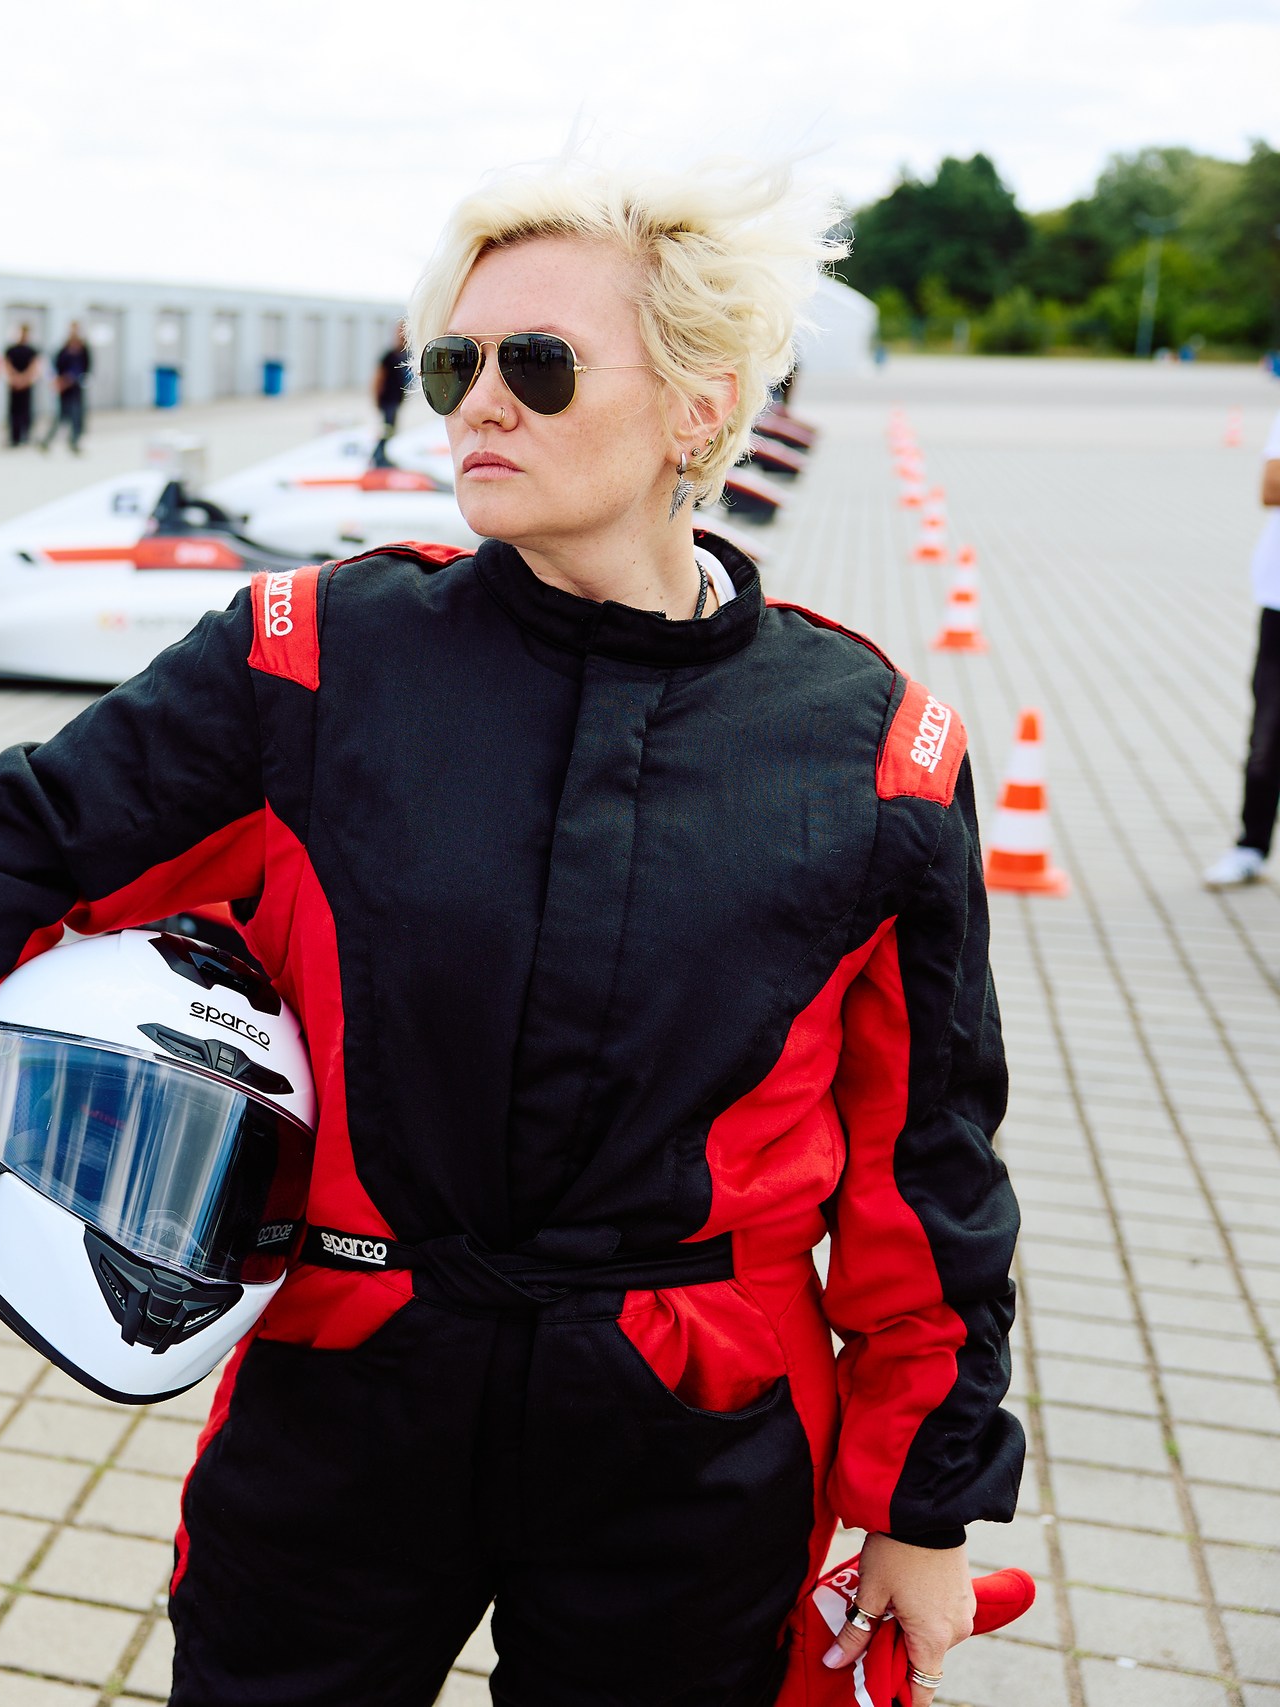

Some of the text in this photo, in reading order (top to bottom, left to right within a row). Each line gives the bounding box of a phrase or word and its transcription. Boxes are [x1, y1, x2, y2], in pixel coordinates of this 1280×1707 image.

[265, 569, 296, 637] parco
[189, 1002, 271, 1049] sparco
[321, 1232, 388, 1264] sparco
